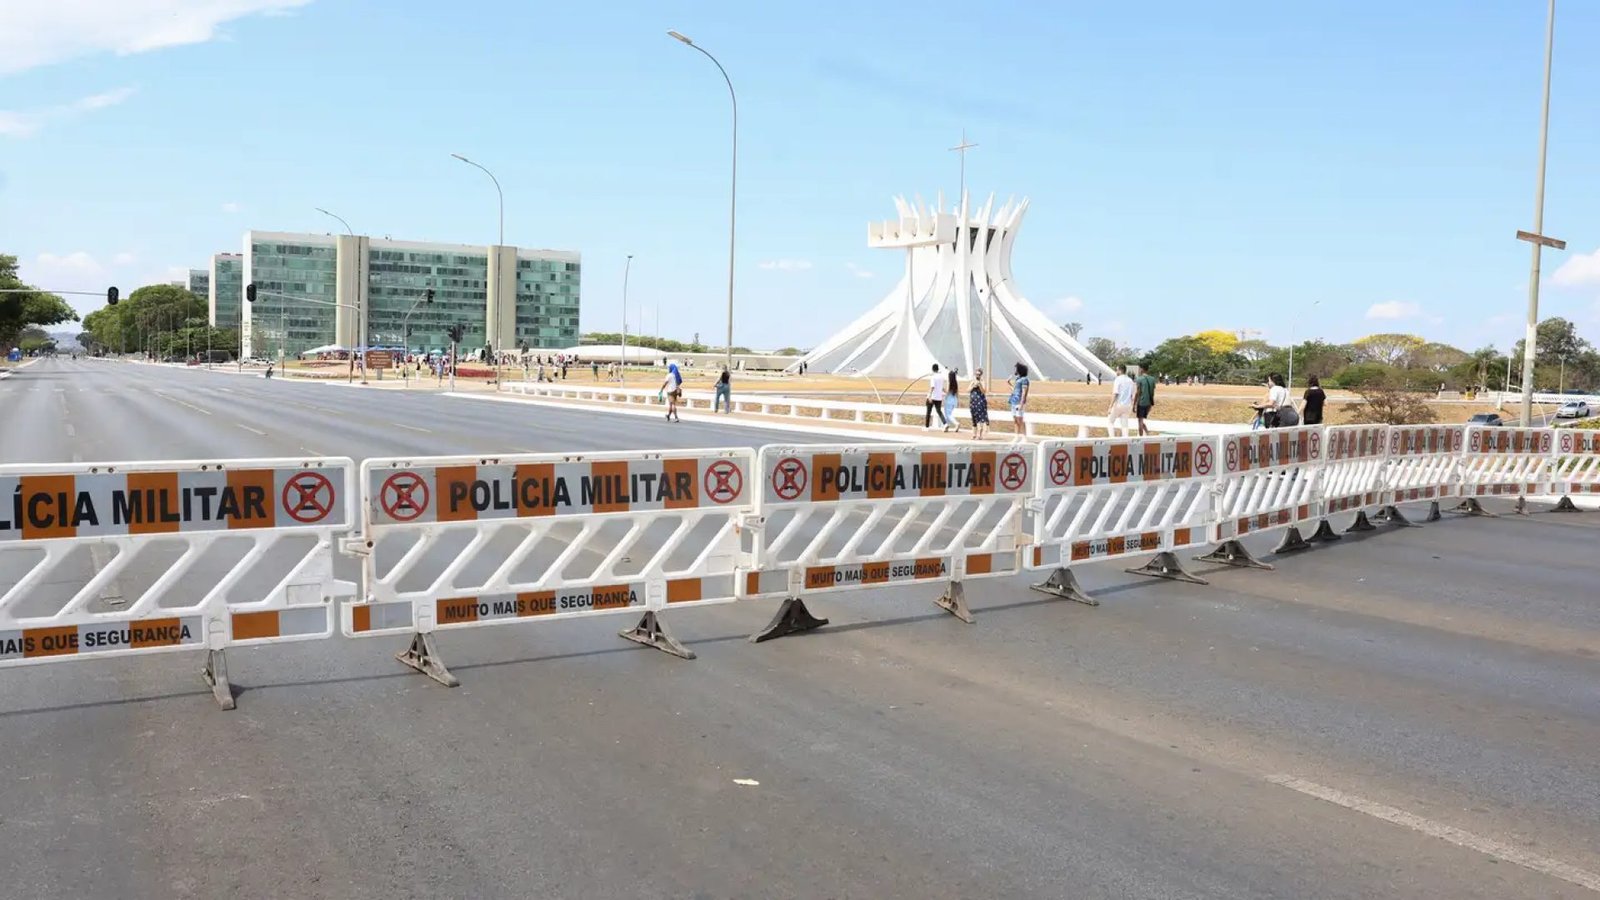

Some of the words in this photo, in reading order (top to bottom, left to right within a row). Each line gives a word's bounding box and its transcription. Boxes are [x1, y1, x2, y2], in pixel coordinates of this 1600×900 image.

[821, 460, 906, 493] POLÍCIA
[912, 463, 991, 490] MILITAR
[1080, 451, 1134, 479] POLÍCIA
[1139, 452, 1190, 476] MILITAR
[112, 486, 267, 525] MILITAR
[450, 471, 571, 512] POLÍCIA
[581, 472, 694, 505] MILITAR
[811, 571, 843, 584] MUITO
[844, 568, 868, 581] MAIS
[871, 567, 889, 579] QUE
[892, 562, 946, 577] SEGURANÇA
[445, 603, 489, 619] MUITO
[493, 600, 526, 616] MAIS
[530, 598, 557, 613] QUE
[560, 590, 637, 609] SEGURANÇA
[0, 636, 36, 655] AIS
[41, 633, 79, 651] QUE
[85, 624, 191, 647] SEGURANÇA
